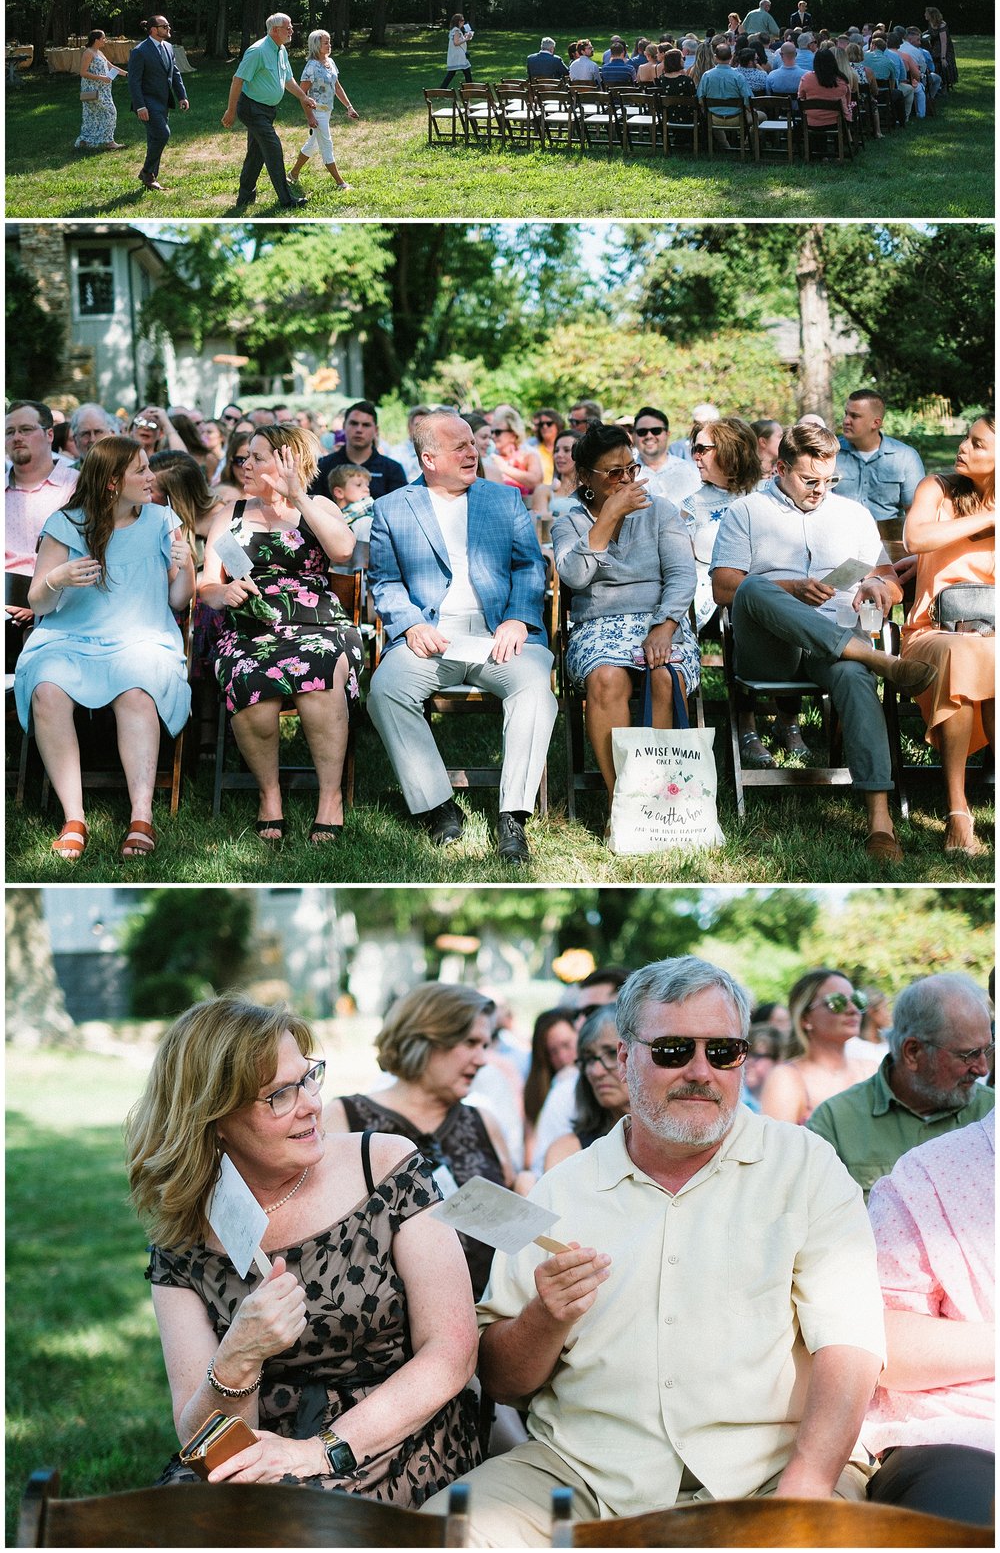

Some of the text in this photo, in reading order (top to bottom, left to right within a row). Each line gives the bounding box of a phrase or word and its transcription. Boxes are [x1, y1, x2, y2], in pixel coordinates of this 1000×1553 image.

[635, 748, 642, 758] A
[644, 746, 668, 757] WISE
[655, 806, 687, 826] outta
